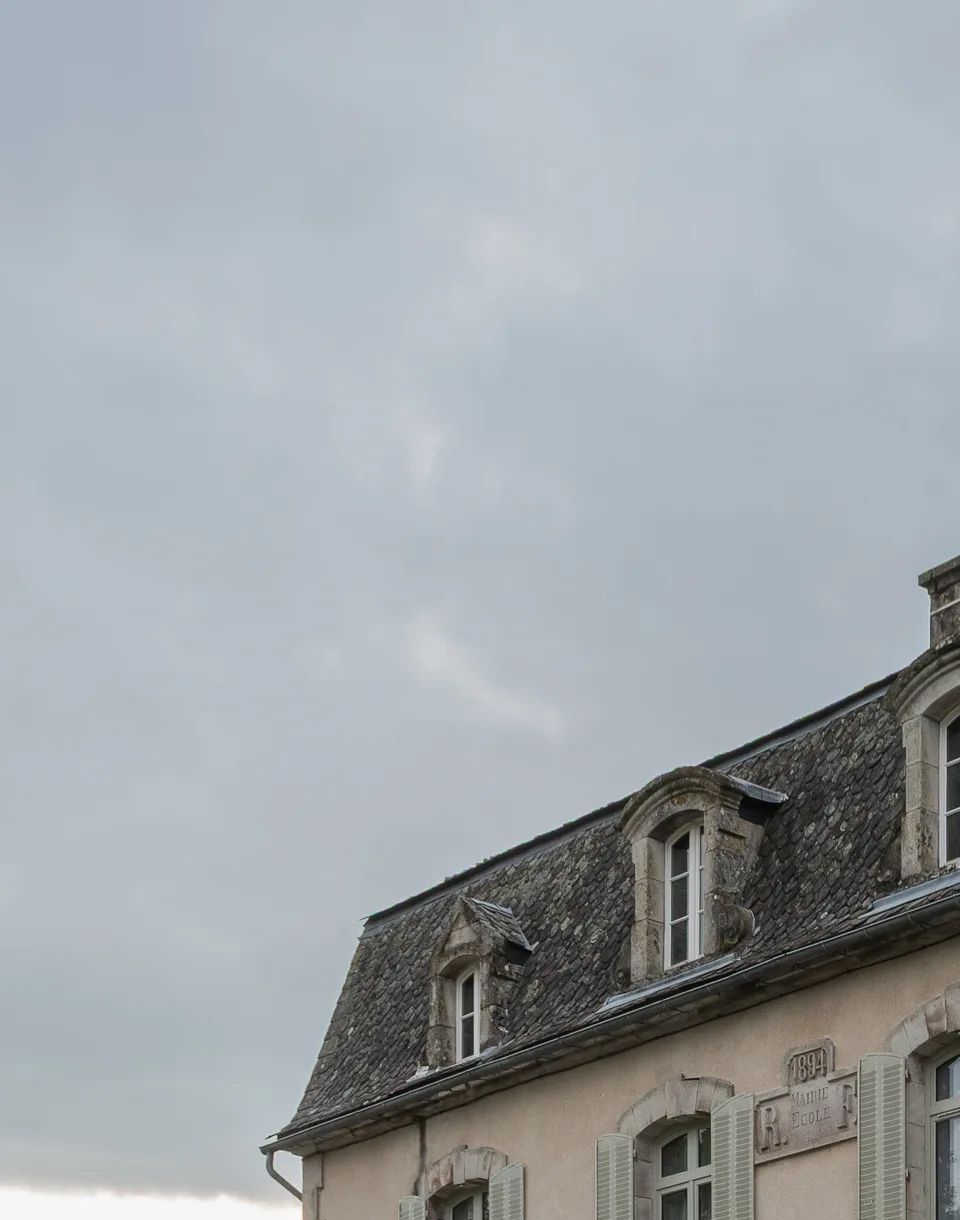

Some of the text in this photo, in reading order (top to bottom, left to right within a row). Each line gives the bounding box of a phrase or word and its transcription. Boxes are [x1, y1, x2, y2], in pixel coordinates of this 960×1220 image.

[791, 1049, 827, 1081] 1894
[791, 1086, 829, 1108] MAIRIE
[791, 1106, 831, 1129] ECOLE
